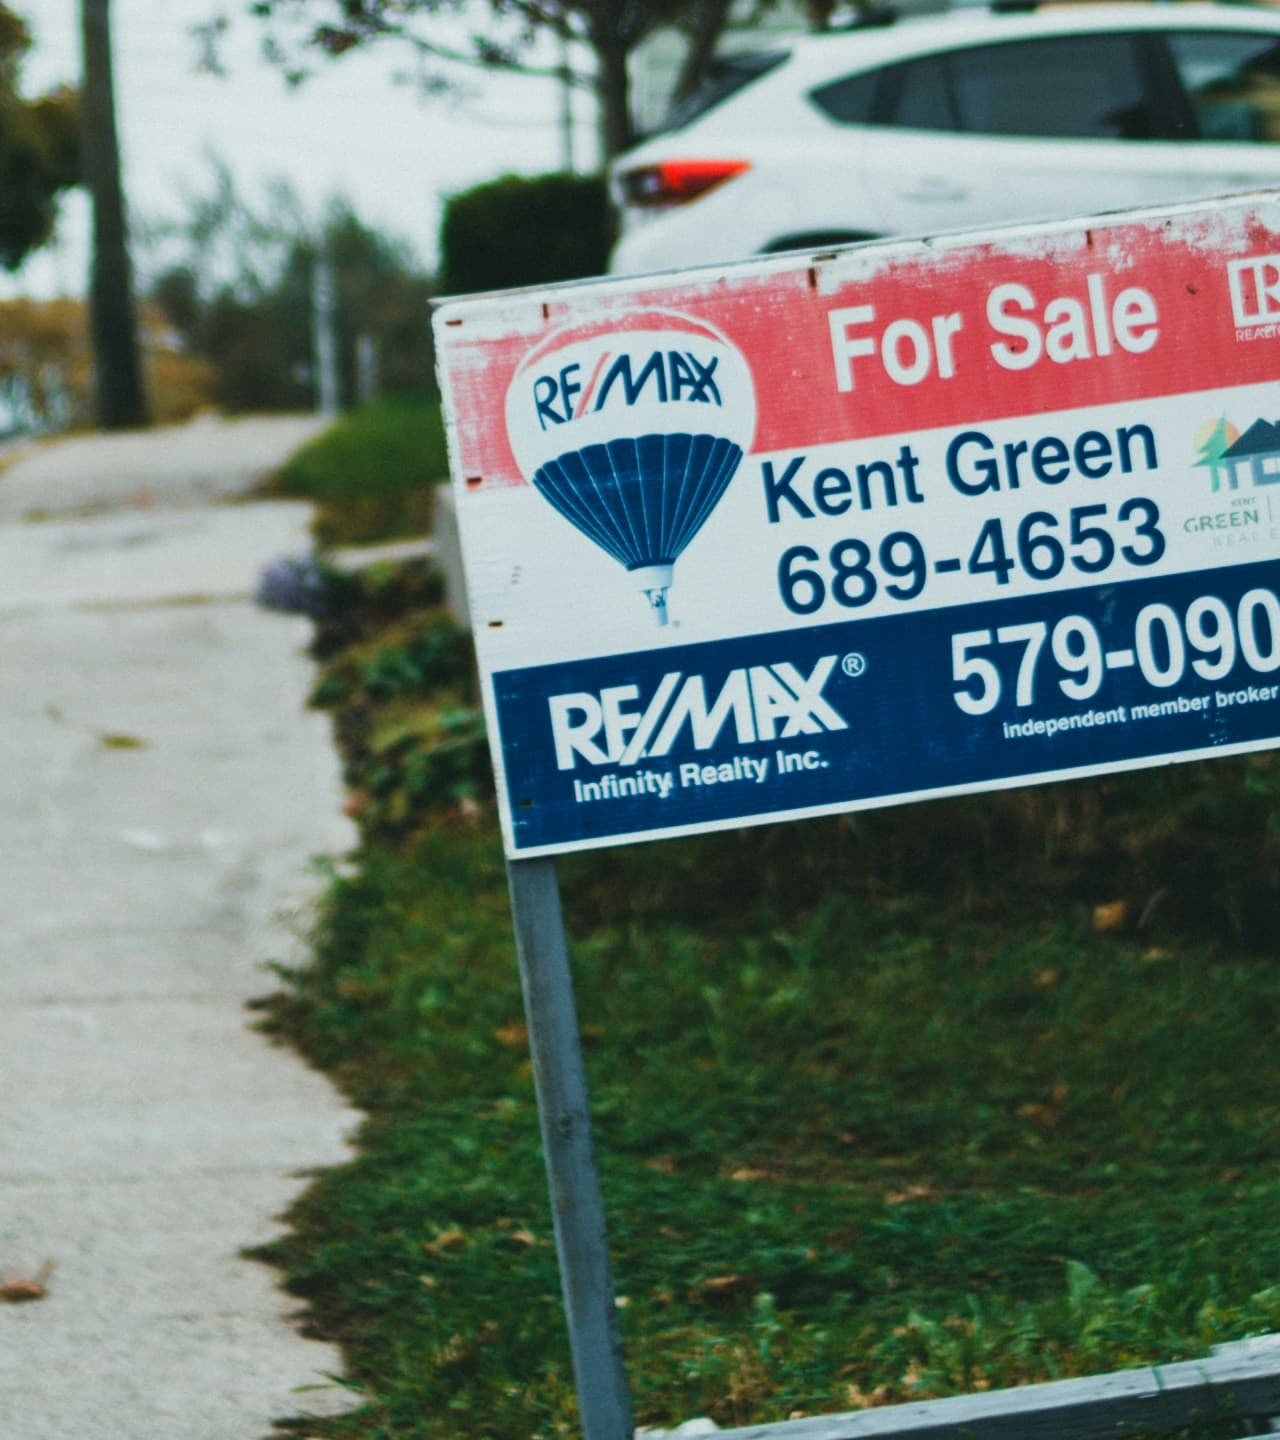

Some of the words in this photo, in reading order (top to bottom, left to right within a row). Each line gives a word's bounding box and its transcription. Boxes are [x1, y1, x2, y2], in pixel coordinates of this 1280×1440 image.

[827, 304, 964, 394] For
[985, 273, 1161, 371] Sale
[533, 350, 723, 432] RE/MAX
[761, 445, 925, 524] Kent
[945, 423, 1159, 497] Green
[776, 496, 1167, 615] 689-4653
[1183, 508, 1260, 534] GREEN
[1002, 705, 1126, 739] independent
[1130, 690, 1211, 722] member
[1214, 685, 1280, 709] broker
[573, 768, 674, 803] Infinity
[679, 756, 769, 788] Realty
[775, 748, 830, 775] Inc.
